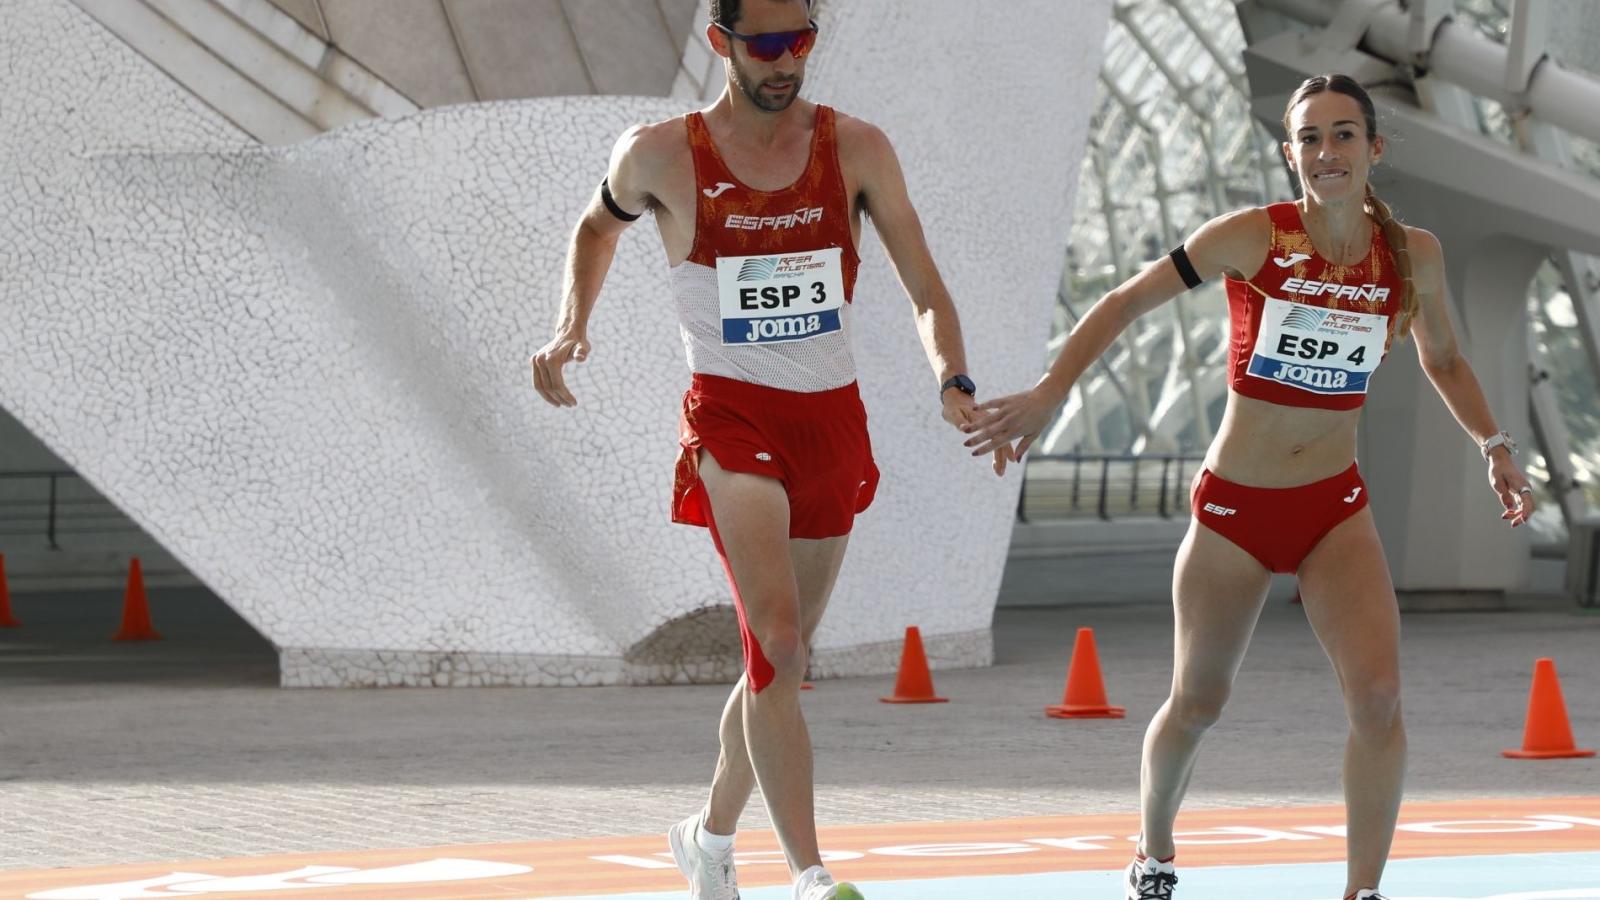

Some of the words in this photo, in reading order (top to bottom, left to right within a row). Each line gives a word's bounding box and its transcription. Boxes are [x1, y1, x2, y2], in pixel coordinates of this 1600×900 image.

[725, 207, 823, 230] ESPAÑA
[775, 261, 826, 273] ATLETISMO
[740, 285, 801, 310] ESP
[810, 281, 826, 304] 3
[1280, 277, 1390, 302] ESPAÑA
[1321, 321, 1372, 333] ATLETISMO
[1276, 333, 1339, 360] ESP
[1347, 346, 1366, 366] 4
[1203, 502, 1237, 516] ESP
